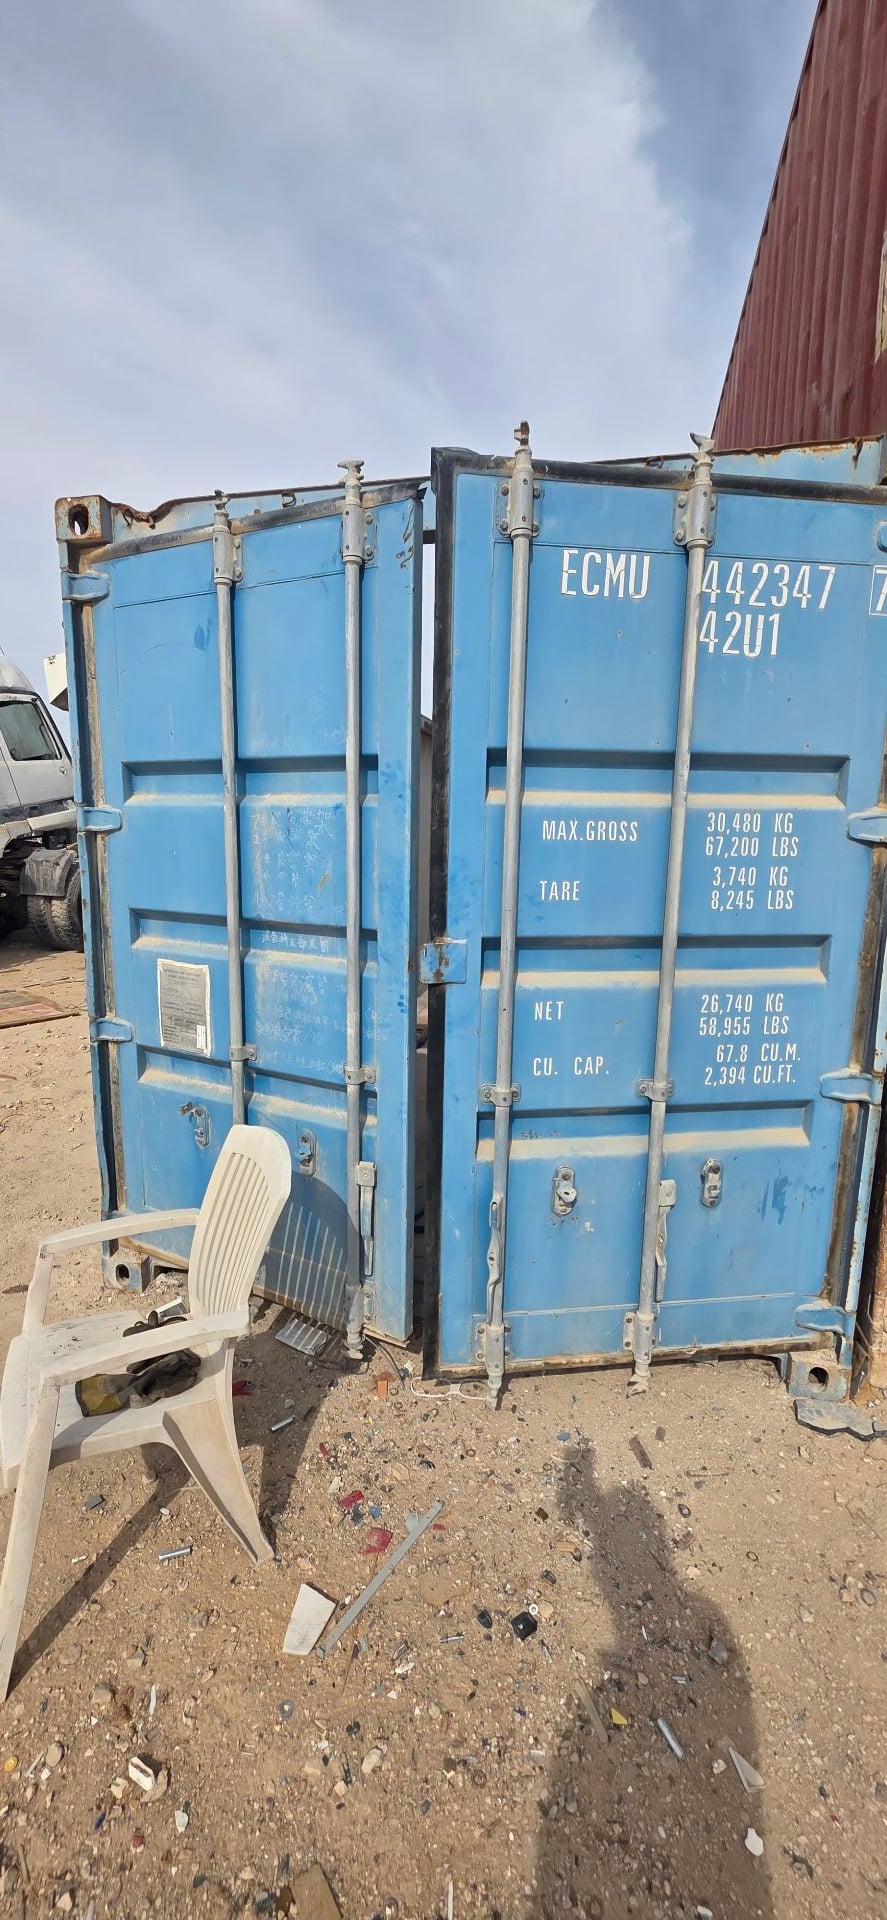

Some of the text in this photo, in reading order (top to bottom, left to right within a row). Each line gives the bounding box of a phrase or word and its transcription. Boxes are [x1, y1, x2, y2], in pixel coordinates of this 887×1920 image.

[560, 549, 651, 600] ECMU
[701, 559, 836, 609] 442347
[699, 610, 781, 658] 42U1
[542, 820, 639, 842] MAX.GROSS
[706, 812, 794, 834] 30,480 KG
[705, 836, 799, 858] 67,200 LBS
[712, 866, 789, 888] 3,740 KG
[539, 880, 581, 901] TARE
[711, 890, 794, 912] 8,245 LBS
[534, 1001, 565, 1021] NET
[700, 993, 784, 1015] 26,740 KG
[699, 1016, 790, 1038] 58,955 LBS
[716, 1043, 801, 1063] 67.8 CU.M.
[532, 1056, 610, 1076] CU. CAP.
[704, 1065, 796, 1087] 2,394 CU.FT.
